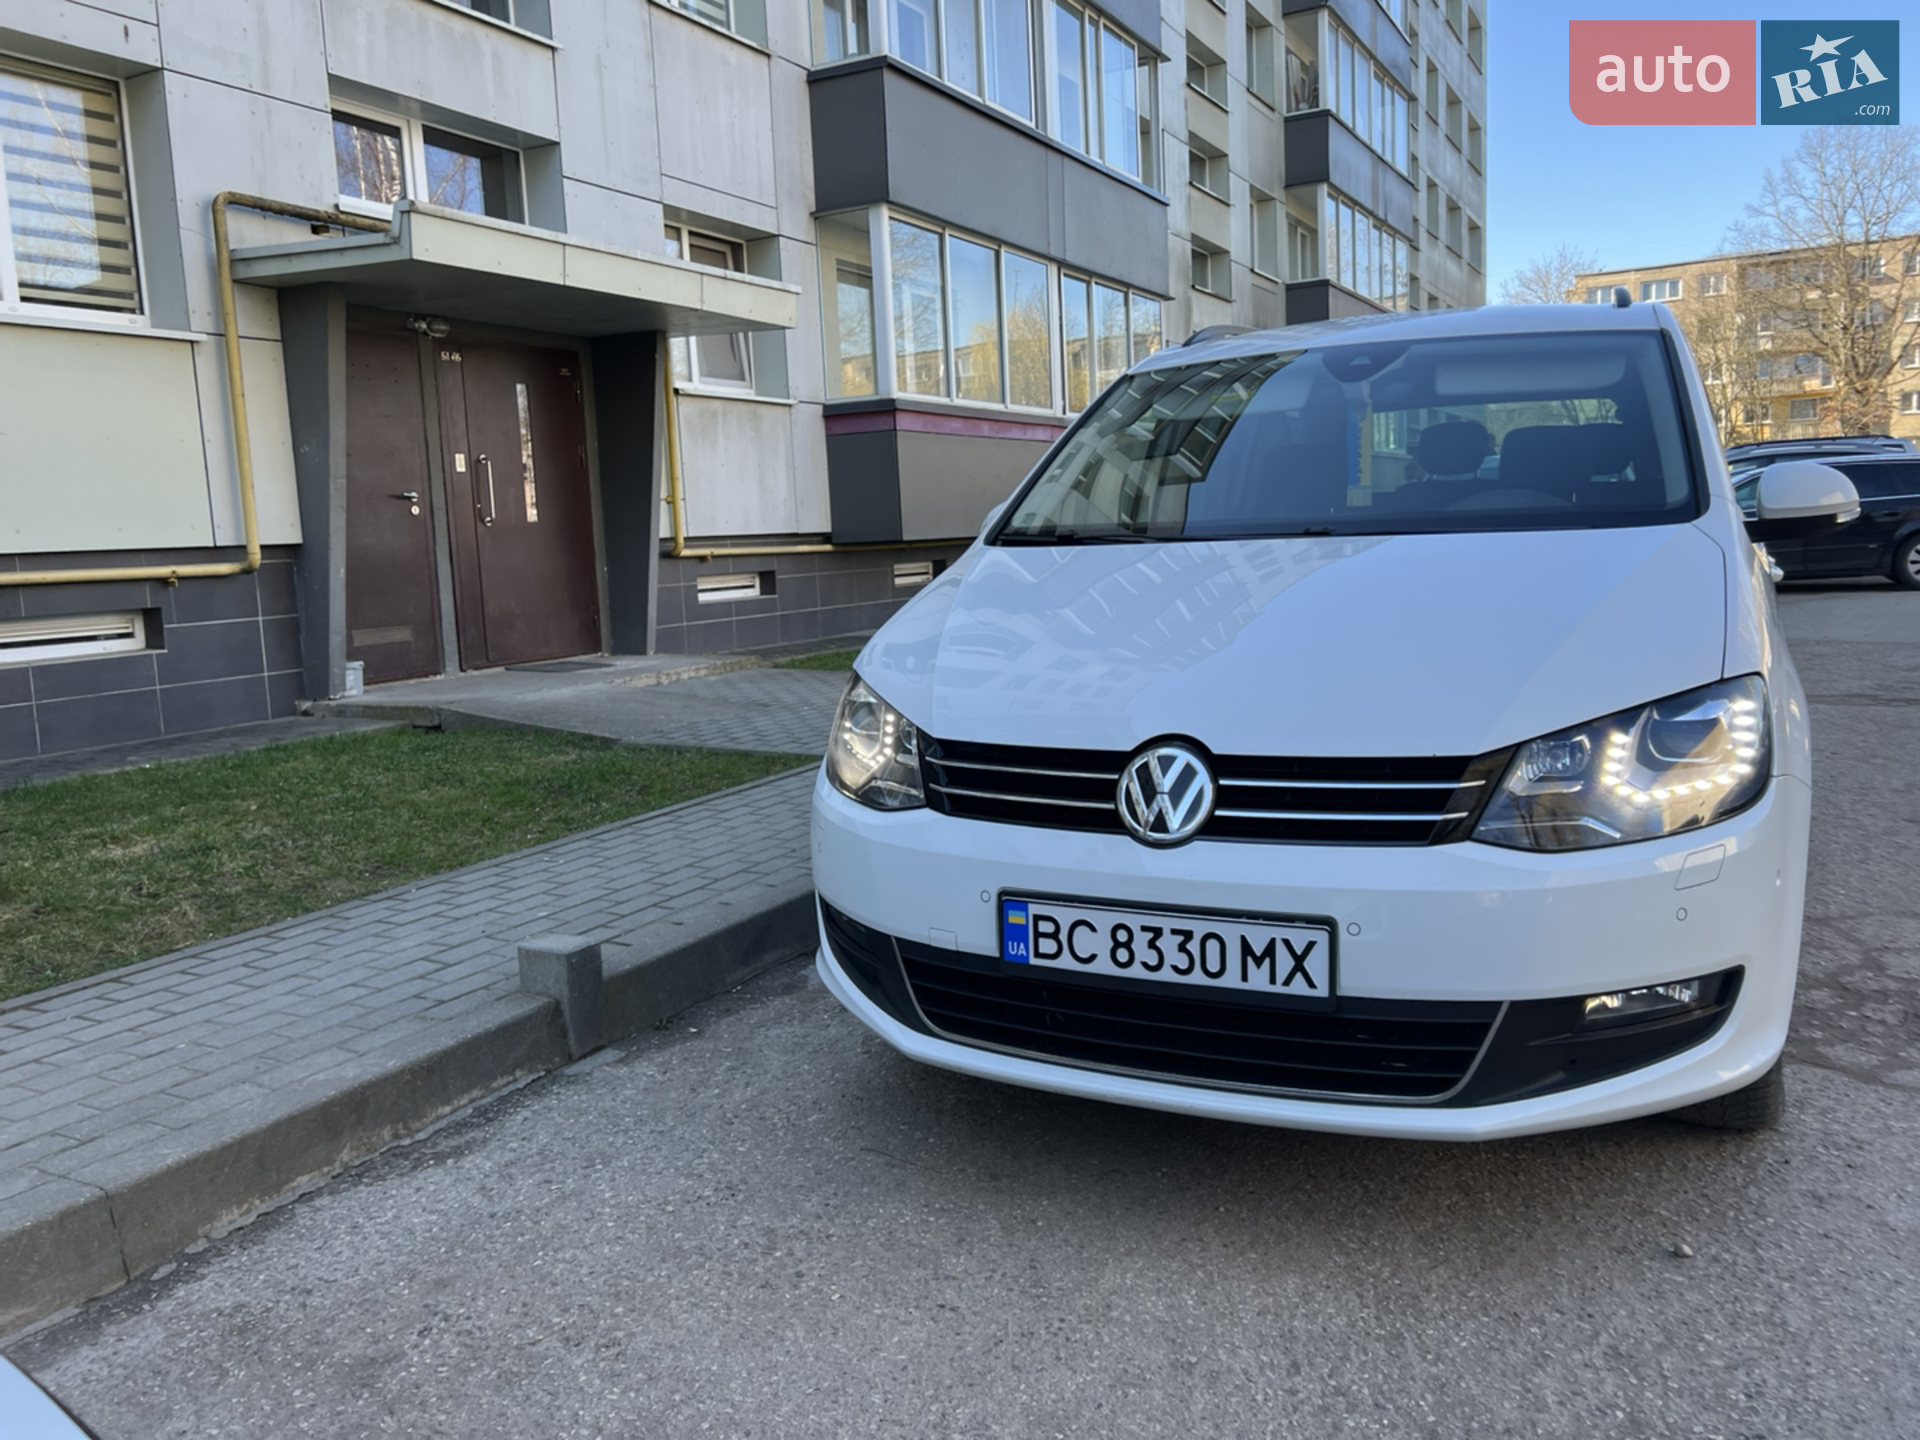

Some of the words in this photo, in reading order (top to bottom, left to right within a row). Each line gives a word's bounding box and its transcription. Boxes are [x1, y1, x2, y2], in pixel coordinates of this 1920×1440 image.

[1008, 940, 1027, 957] UA
[1032, 913, 1099, 965] BC
[1110, 922, 1228, 980] 8330
[1240, 934, 1319, 990] MX
